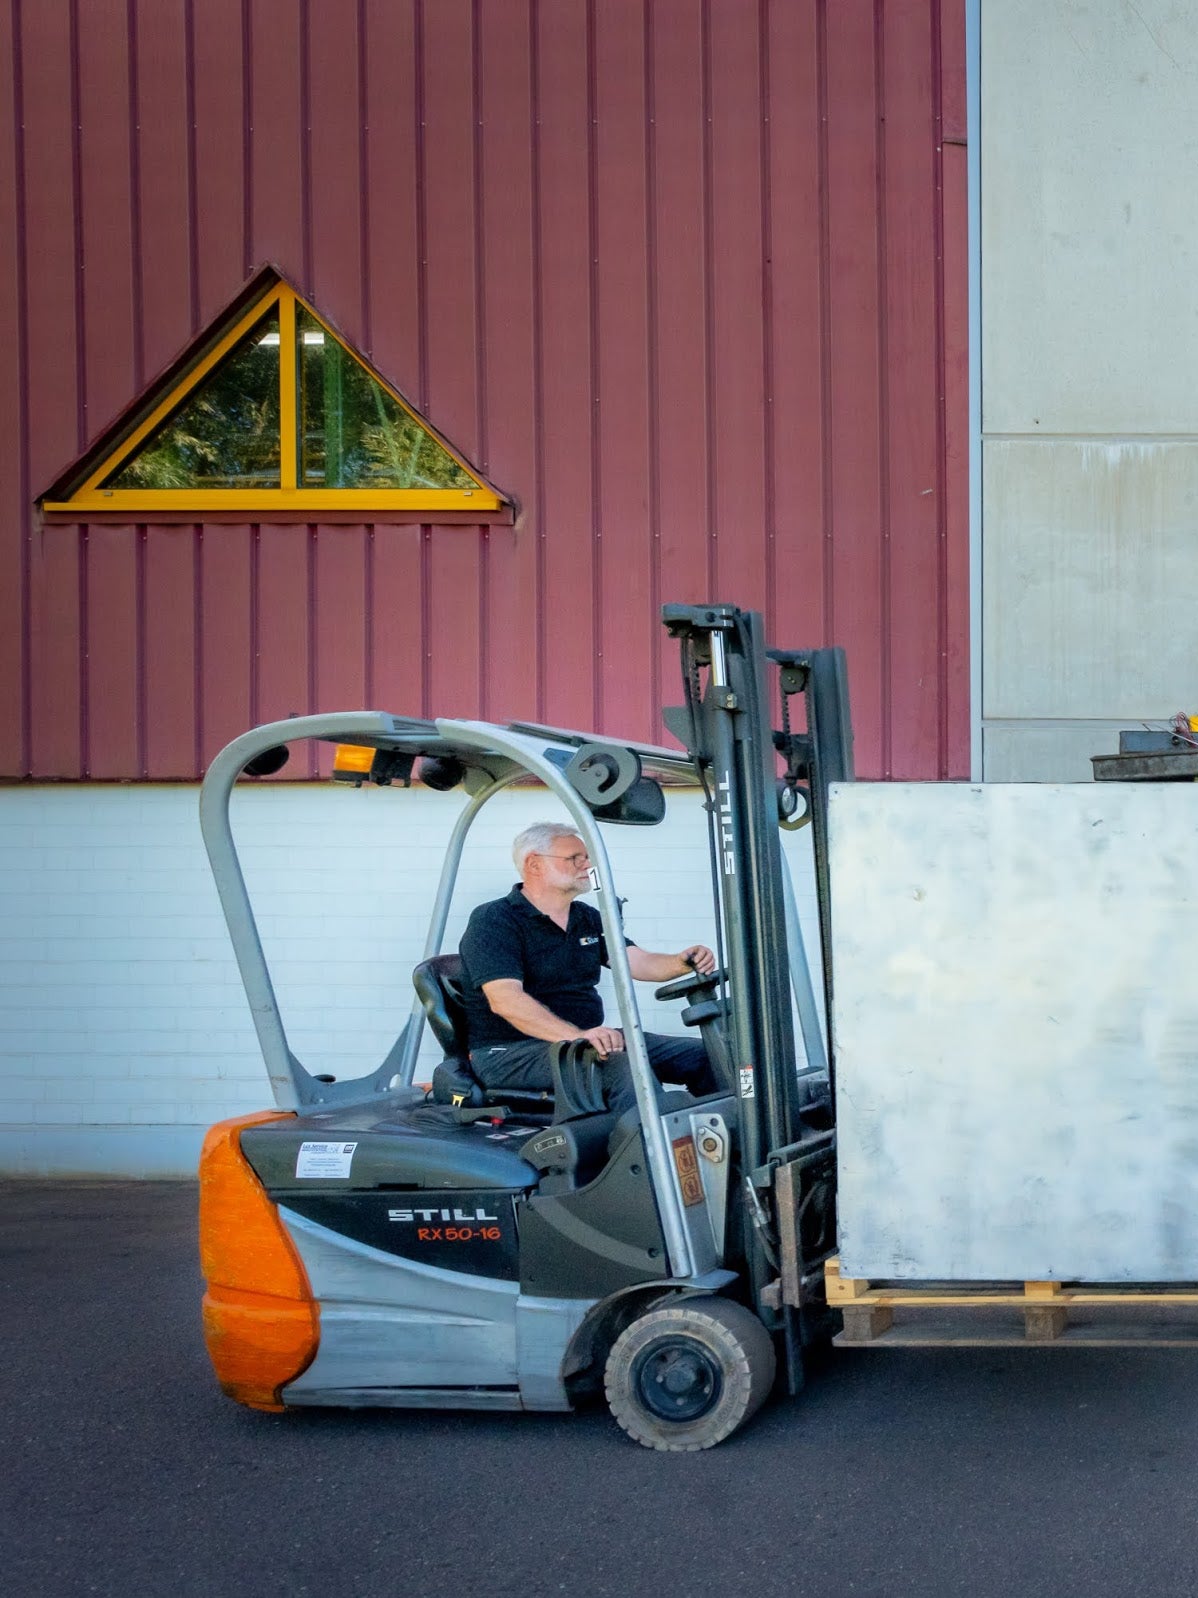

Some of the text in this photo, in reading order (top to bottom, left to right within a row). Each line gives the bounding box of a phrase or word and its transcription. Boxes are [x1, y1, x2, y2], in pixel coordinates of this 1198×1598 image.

[719, 769, 735, 875] STILL
[590, 868, 601, 891] 1
[388, 1208, 498, 1222] STILL
[417, 1226, 501, 1241] RX 50-16
